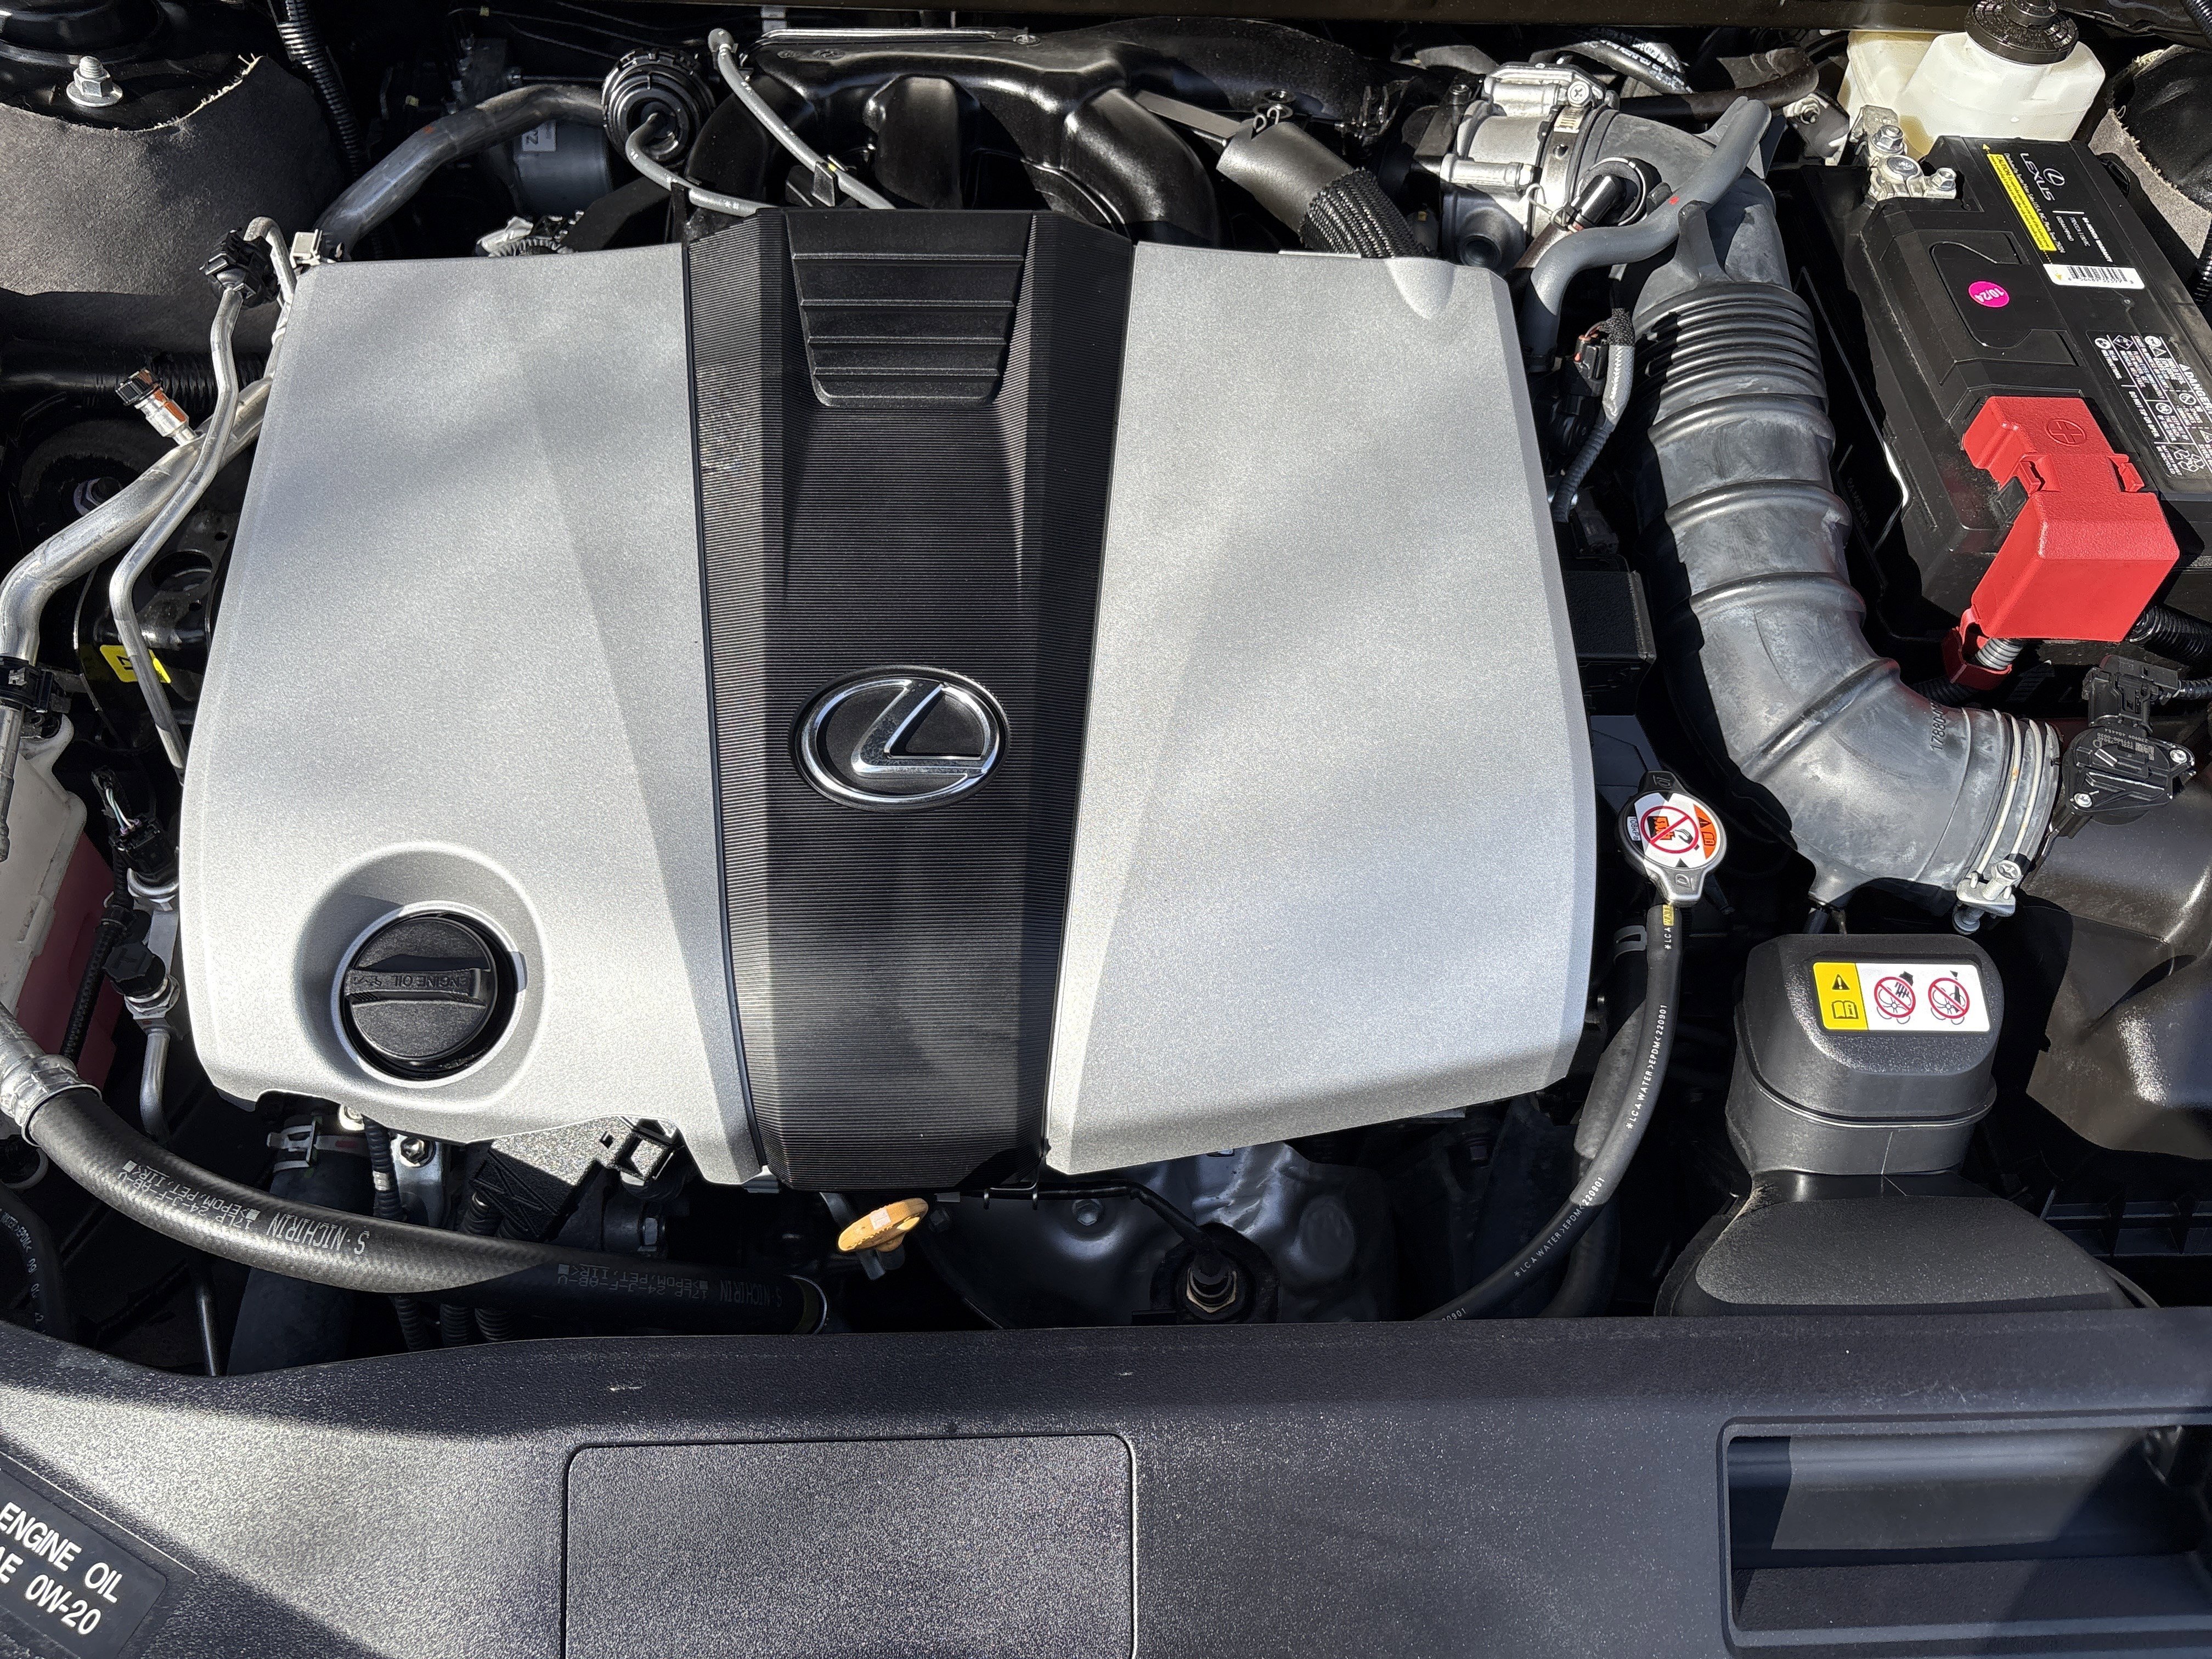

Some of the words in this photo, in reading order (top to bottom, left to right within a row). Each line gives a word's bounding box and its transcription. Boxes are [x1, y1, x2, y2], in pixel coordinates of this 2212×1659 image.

[2020, 153, 2056, 201] LEXUS
[1974, 288, 2005, 303] 10/24
[2133, 398, 2144, 409] NOT
[1629, 817, 1639, 840] 108kPa
[391, 975, 414, 988] OIL
[417, 975, 467, 989] ENGINE
[0, 1501, 82, 1572] ENGINE
[84, 1562, 123, 1604] OIL
[25, 1574, 101, 1635] 0W-20
